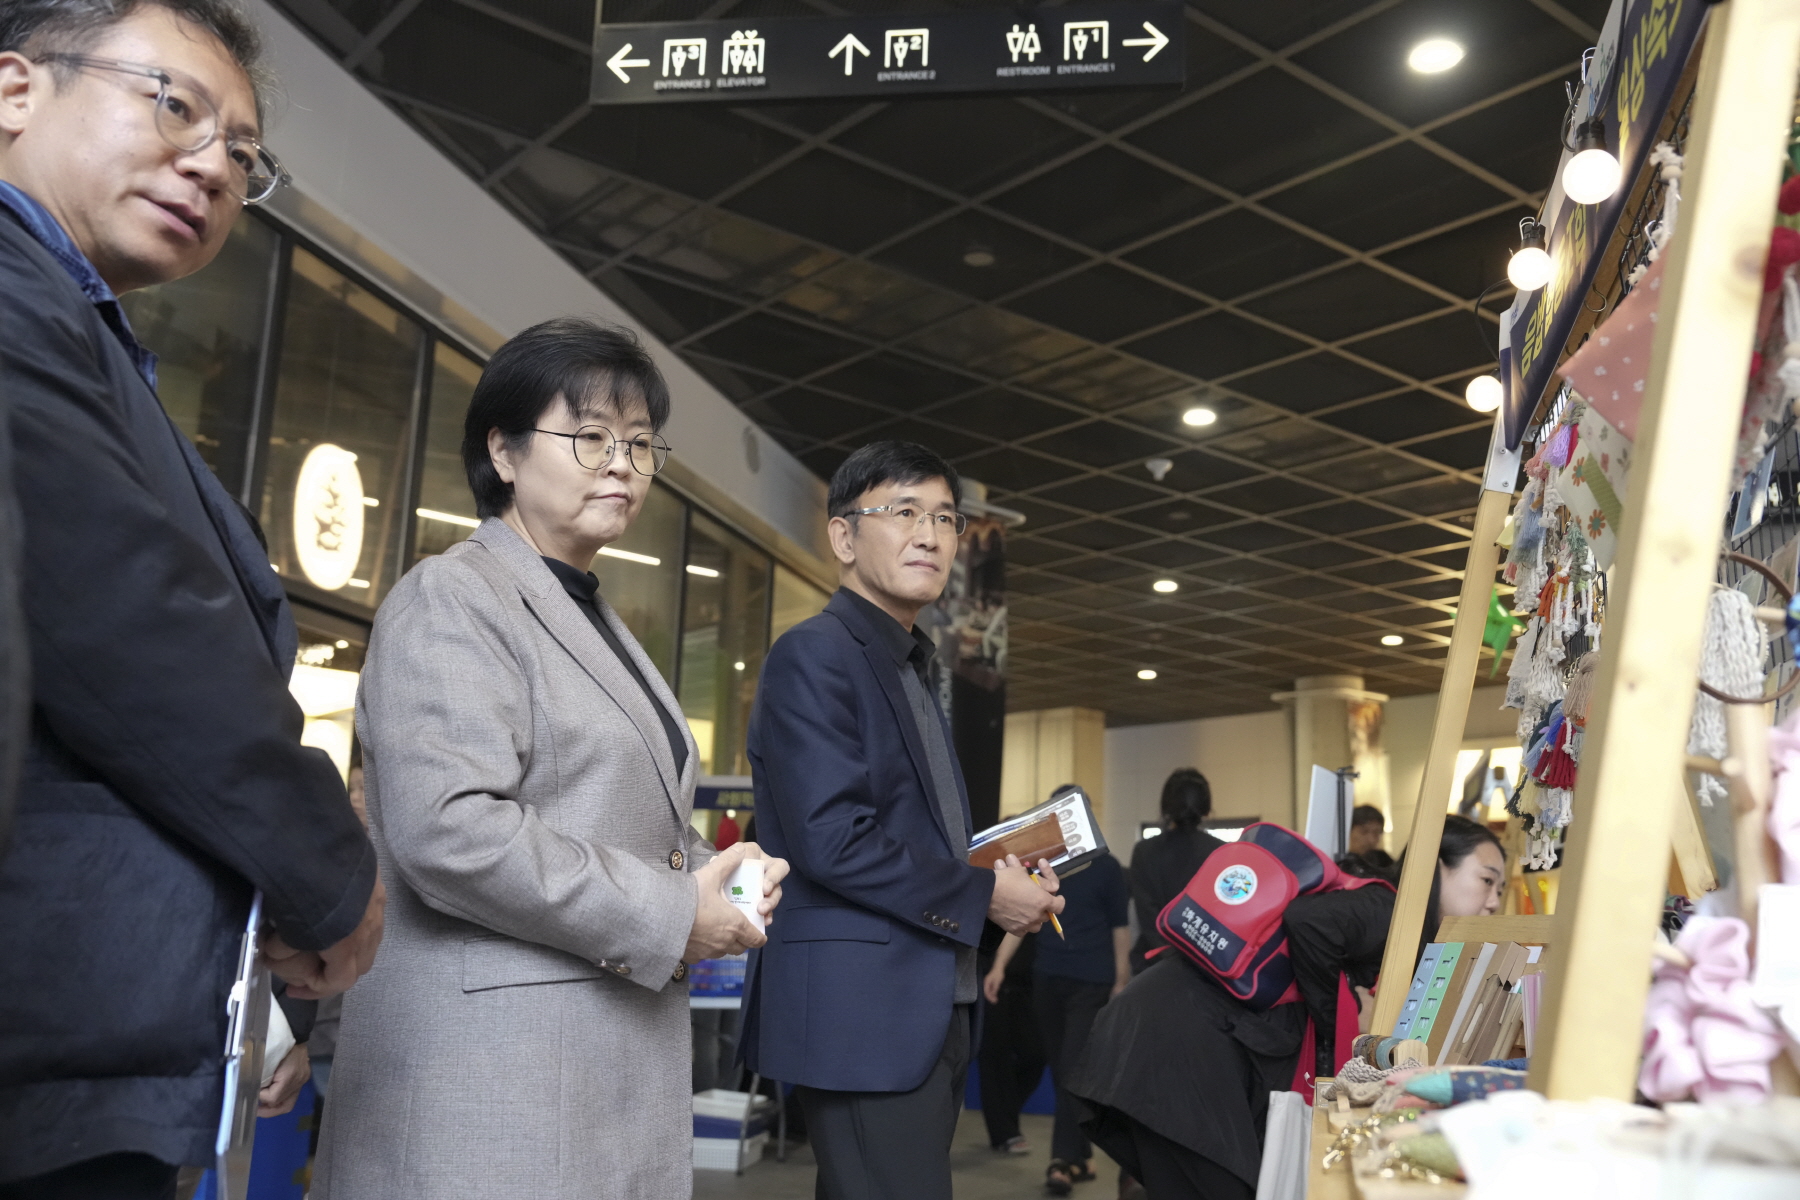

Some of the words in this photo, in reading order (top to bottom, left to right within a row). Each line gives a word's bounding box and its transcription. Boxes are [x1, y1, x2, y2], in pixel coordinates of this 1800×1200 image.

[910, 35, 922, 51] 2
[687, 45, 700, 60] 3
[996, 65, 1051, 77] RESTROOM
[716, 76, 766, 88] ELEVATOR
